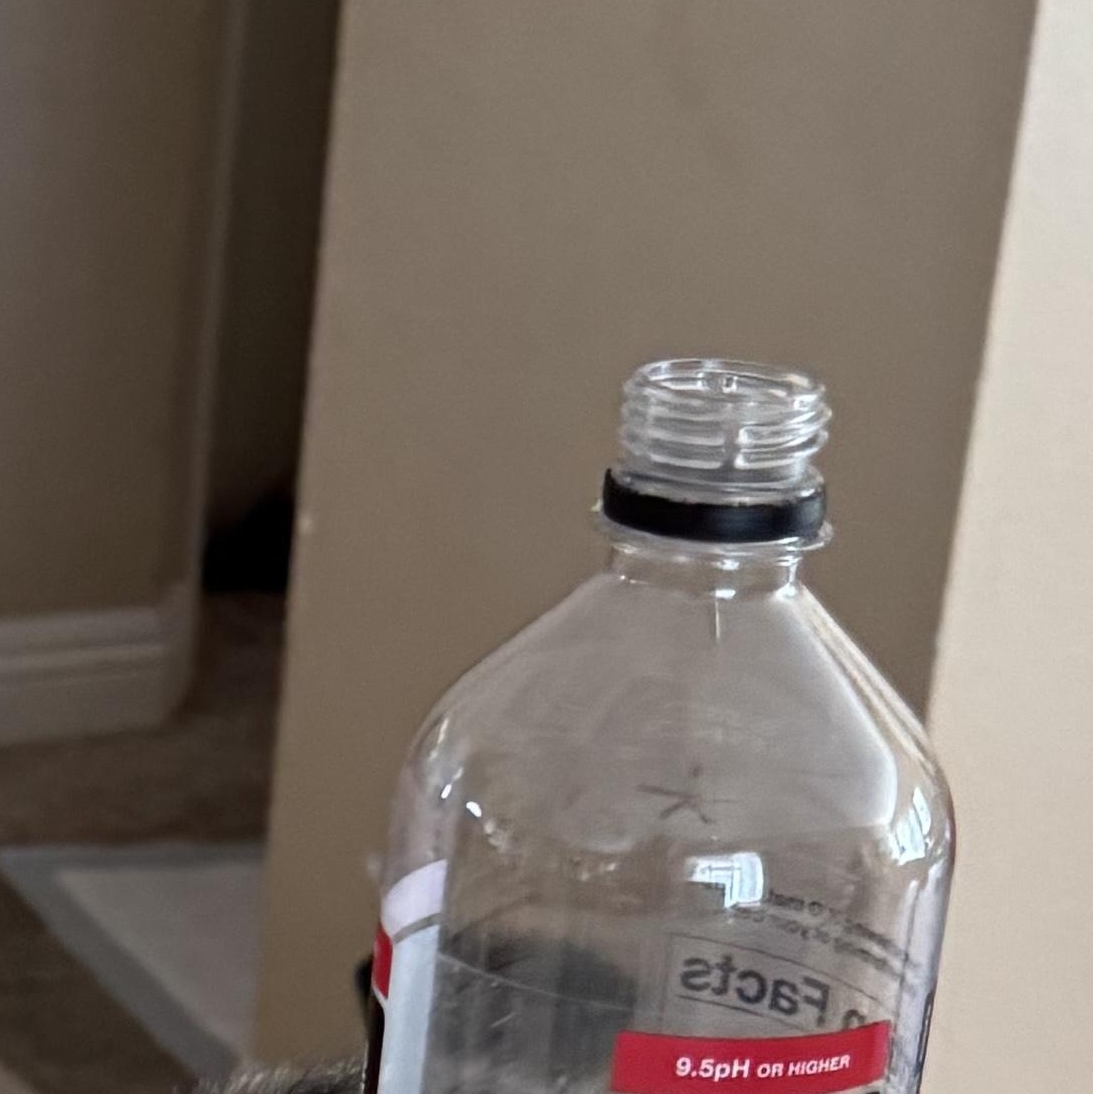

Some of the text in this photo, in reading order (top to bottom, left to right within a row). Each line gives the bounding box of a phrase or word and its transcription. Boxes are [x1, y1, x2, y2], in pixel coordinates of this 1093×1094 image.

[675, 1054, 851, 1082] 9.5pH OR HIGHER
